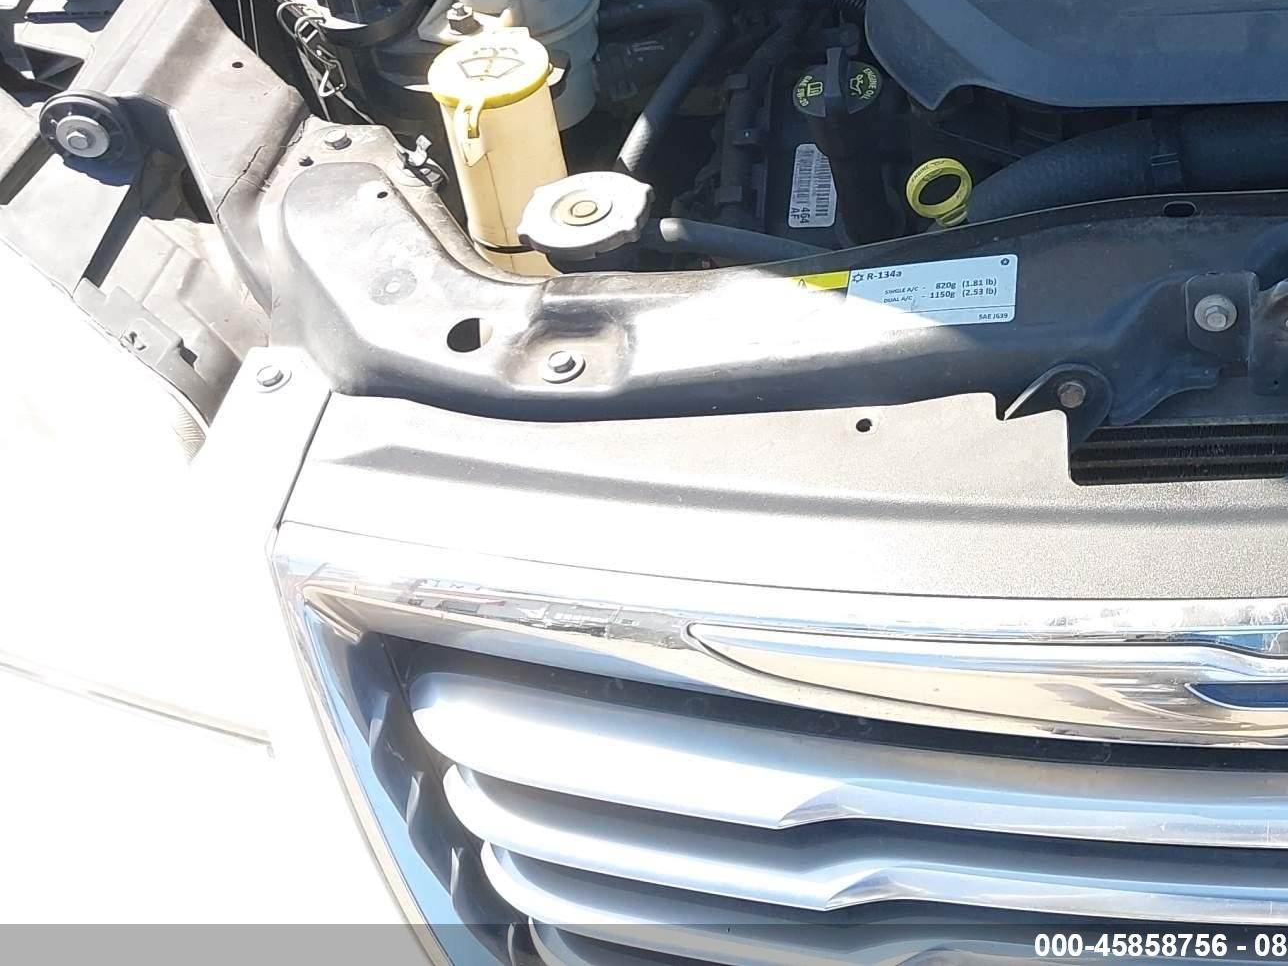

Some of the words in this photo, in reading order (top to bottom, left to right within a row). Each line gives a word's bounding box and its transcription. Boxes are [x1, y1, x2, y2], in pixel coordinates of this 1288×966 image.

[863, 67, 877, 89] ENGINE
[860, 89, 875, 100] OIL
[867, 270, 902, 281] R-134a
[936, 281, 957, 290] 820g
[962, 280, 984, 289] (1.81
[985, 278, 997, 287] lb)
[930, 291, 956, 299] 1150g
[962, 289, 984, 298] (2.53
[985, 287, 997, 296] lb)
[978, 313, 992, 321] SAE
[992, 312, 1009, 320] J639
